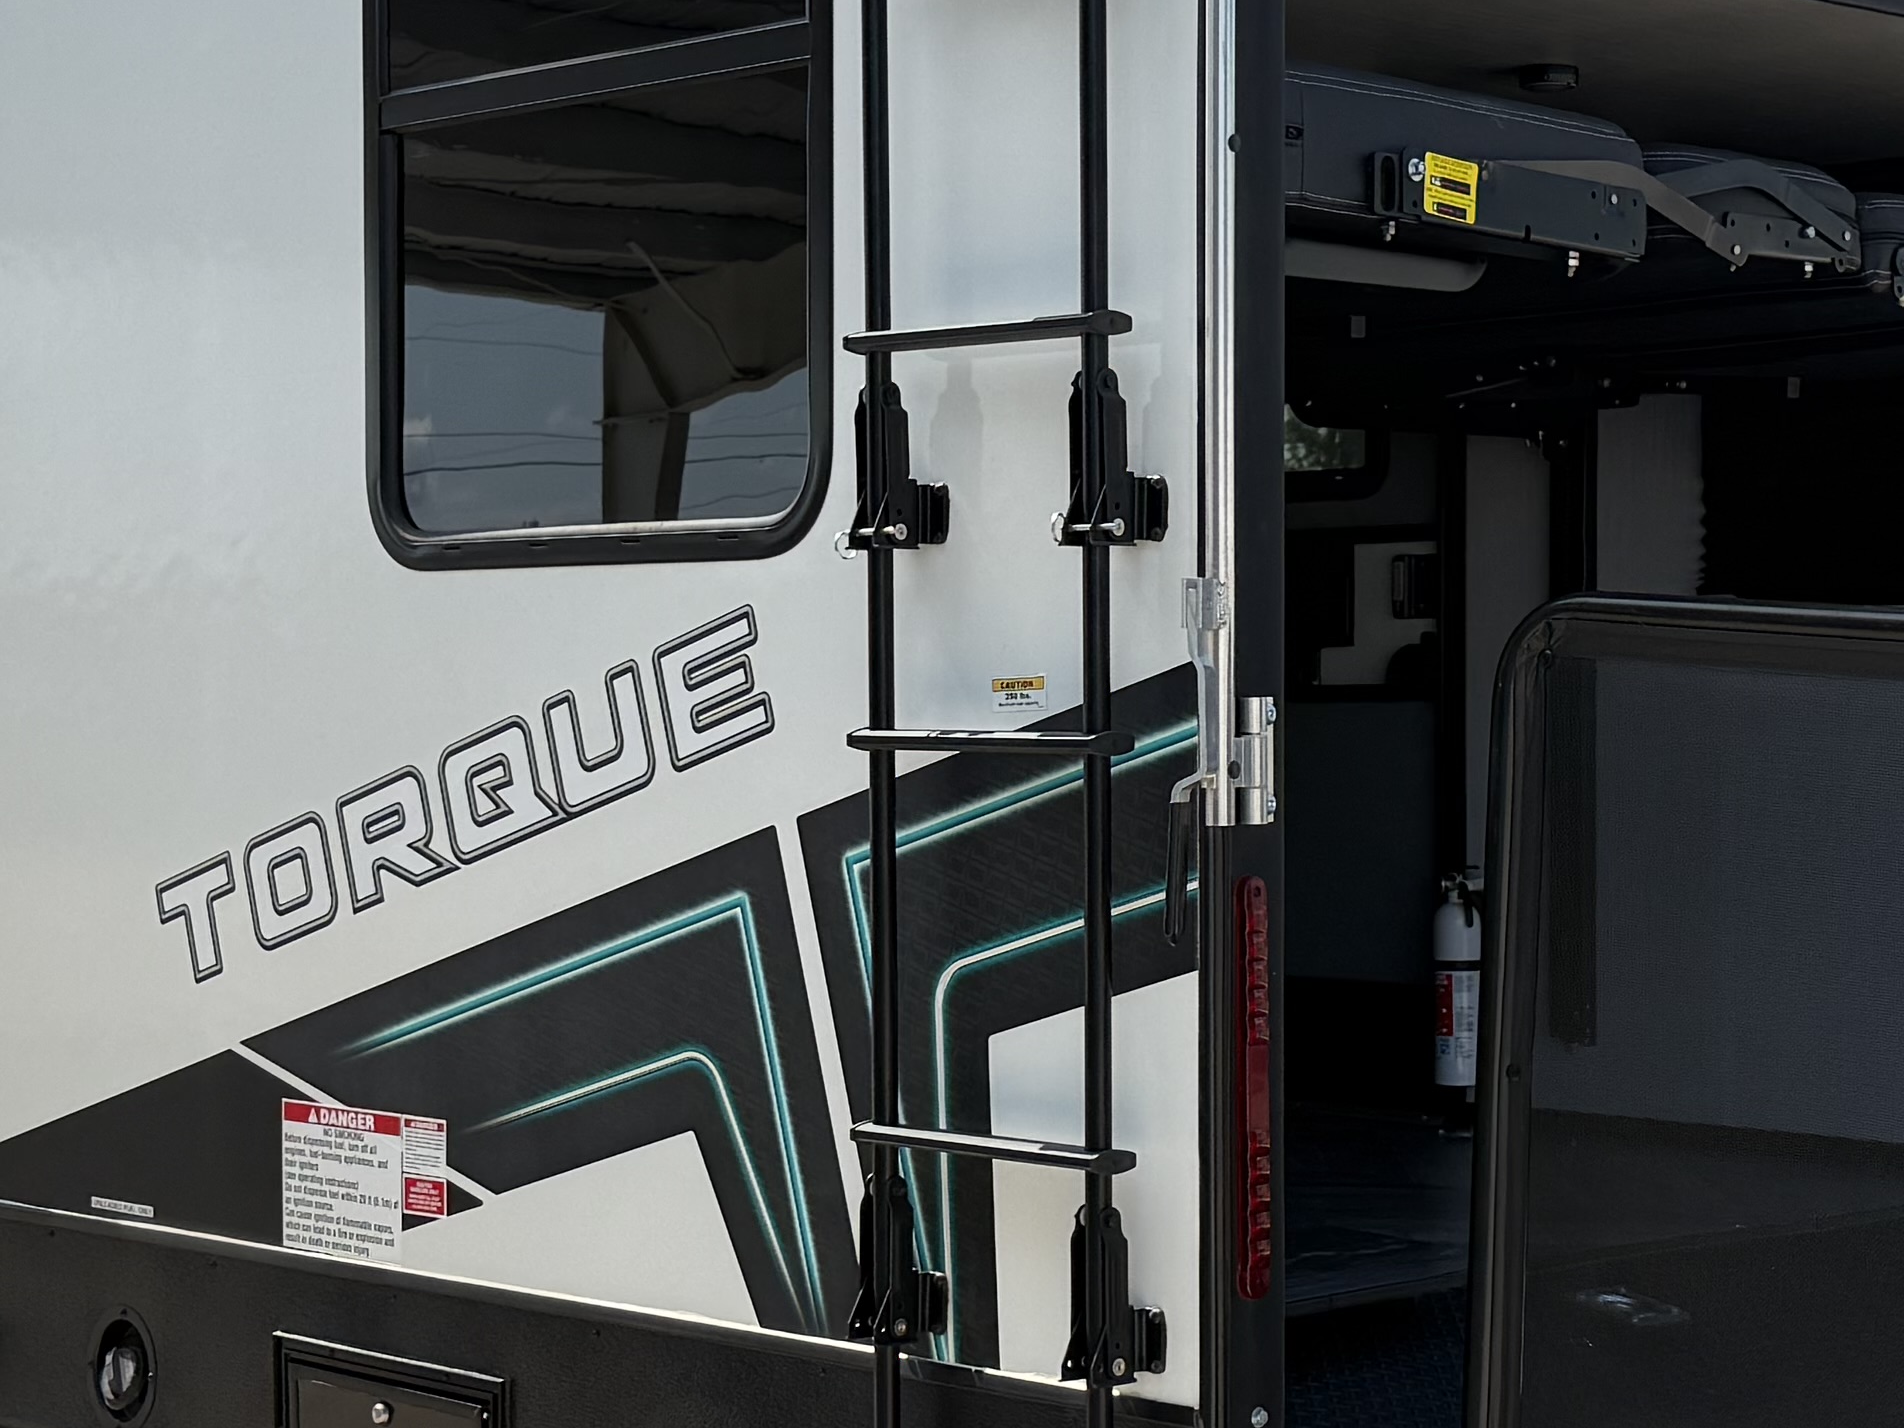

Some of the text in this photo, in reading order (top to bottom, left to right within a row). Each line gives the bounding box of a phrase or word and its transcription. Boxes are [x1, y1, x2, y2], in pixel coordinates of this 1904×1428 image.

[1000, 681, 1034, 690] CAUTION
[156, 604, 774, 983] TORQUE
[320, 1109, 375, 1131] DANGER
[323, 1128, 364, 1142] NO SMOKING
